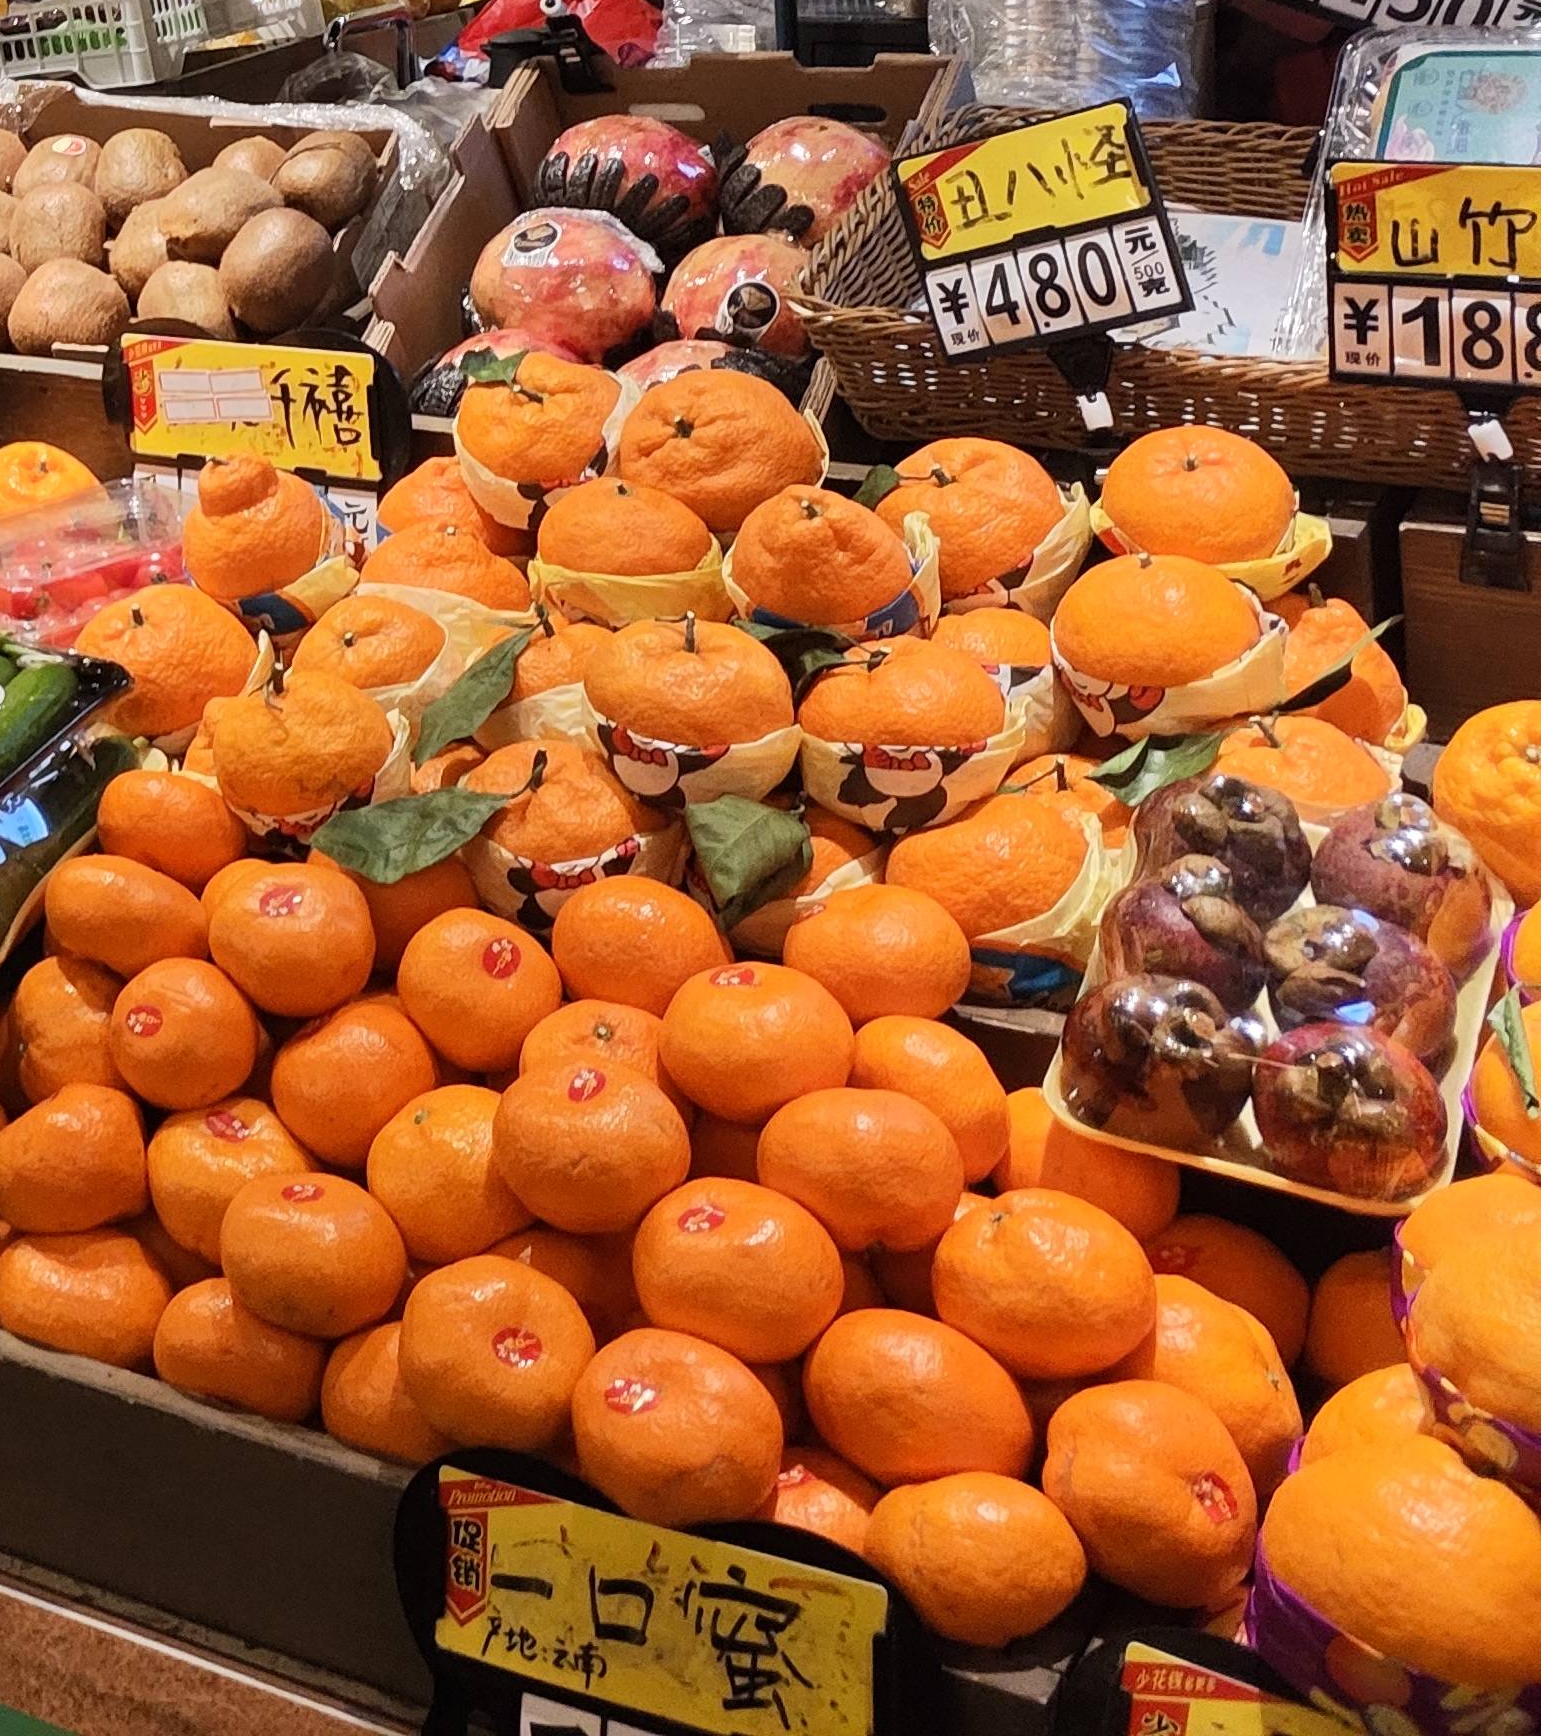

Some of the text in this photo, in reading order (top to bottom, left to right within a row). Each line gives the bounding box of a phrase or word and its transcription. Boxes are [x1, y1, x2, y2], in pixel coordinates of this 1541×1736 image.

[944, 124, 1134, 231] 丑八怪
[1338, 169, 1404, 197] Hot Sale
[917, 193, 943, 235] 特价
[1390, 196, 1538, 272] 山竹
[950, 329, 981, 347] 现价
[1344, 351, 1381, 368] 现价
[447, 1486, 518, 1507] Promotion
[448, 1515, 484, 1594] 促销
